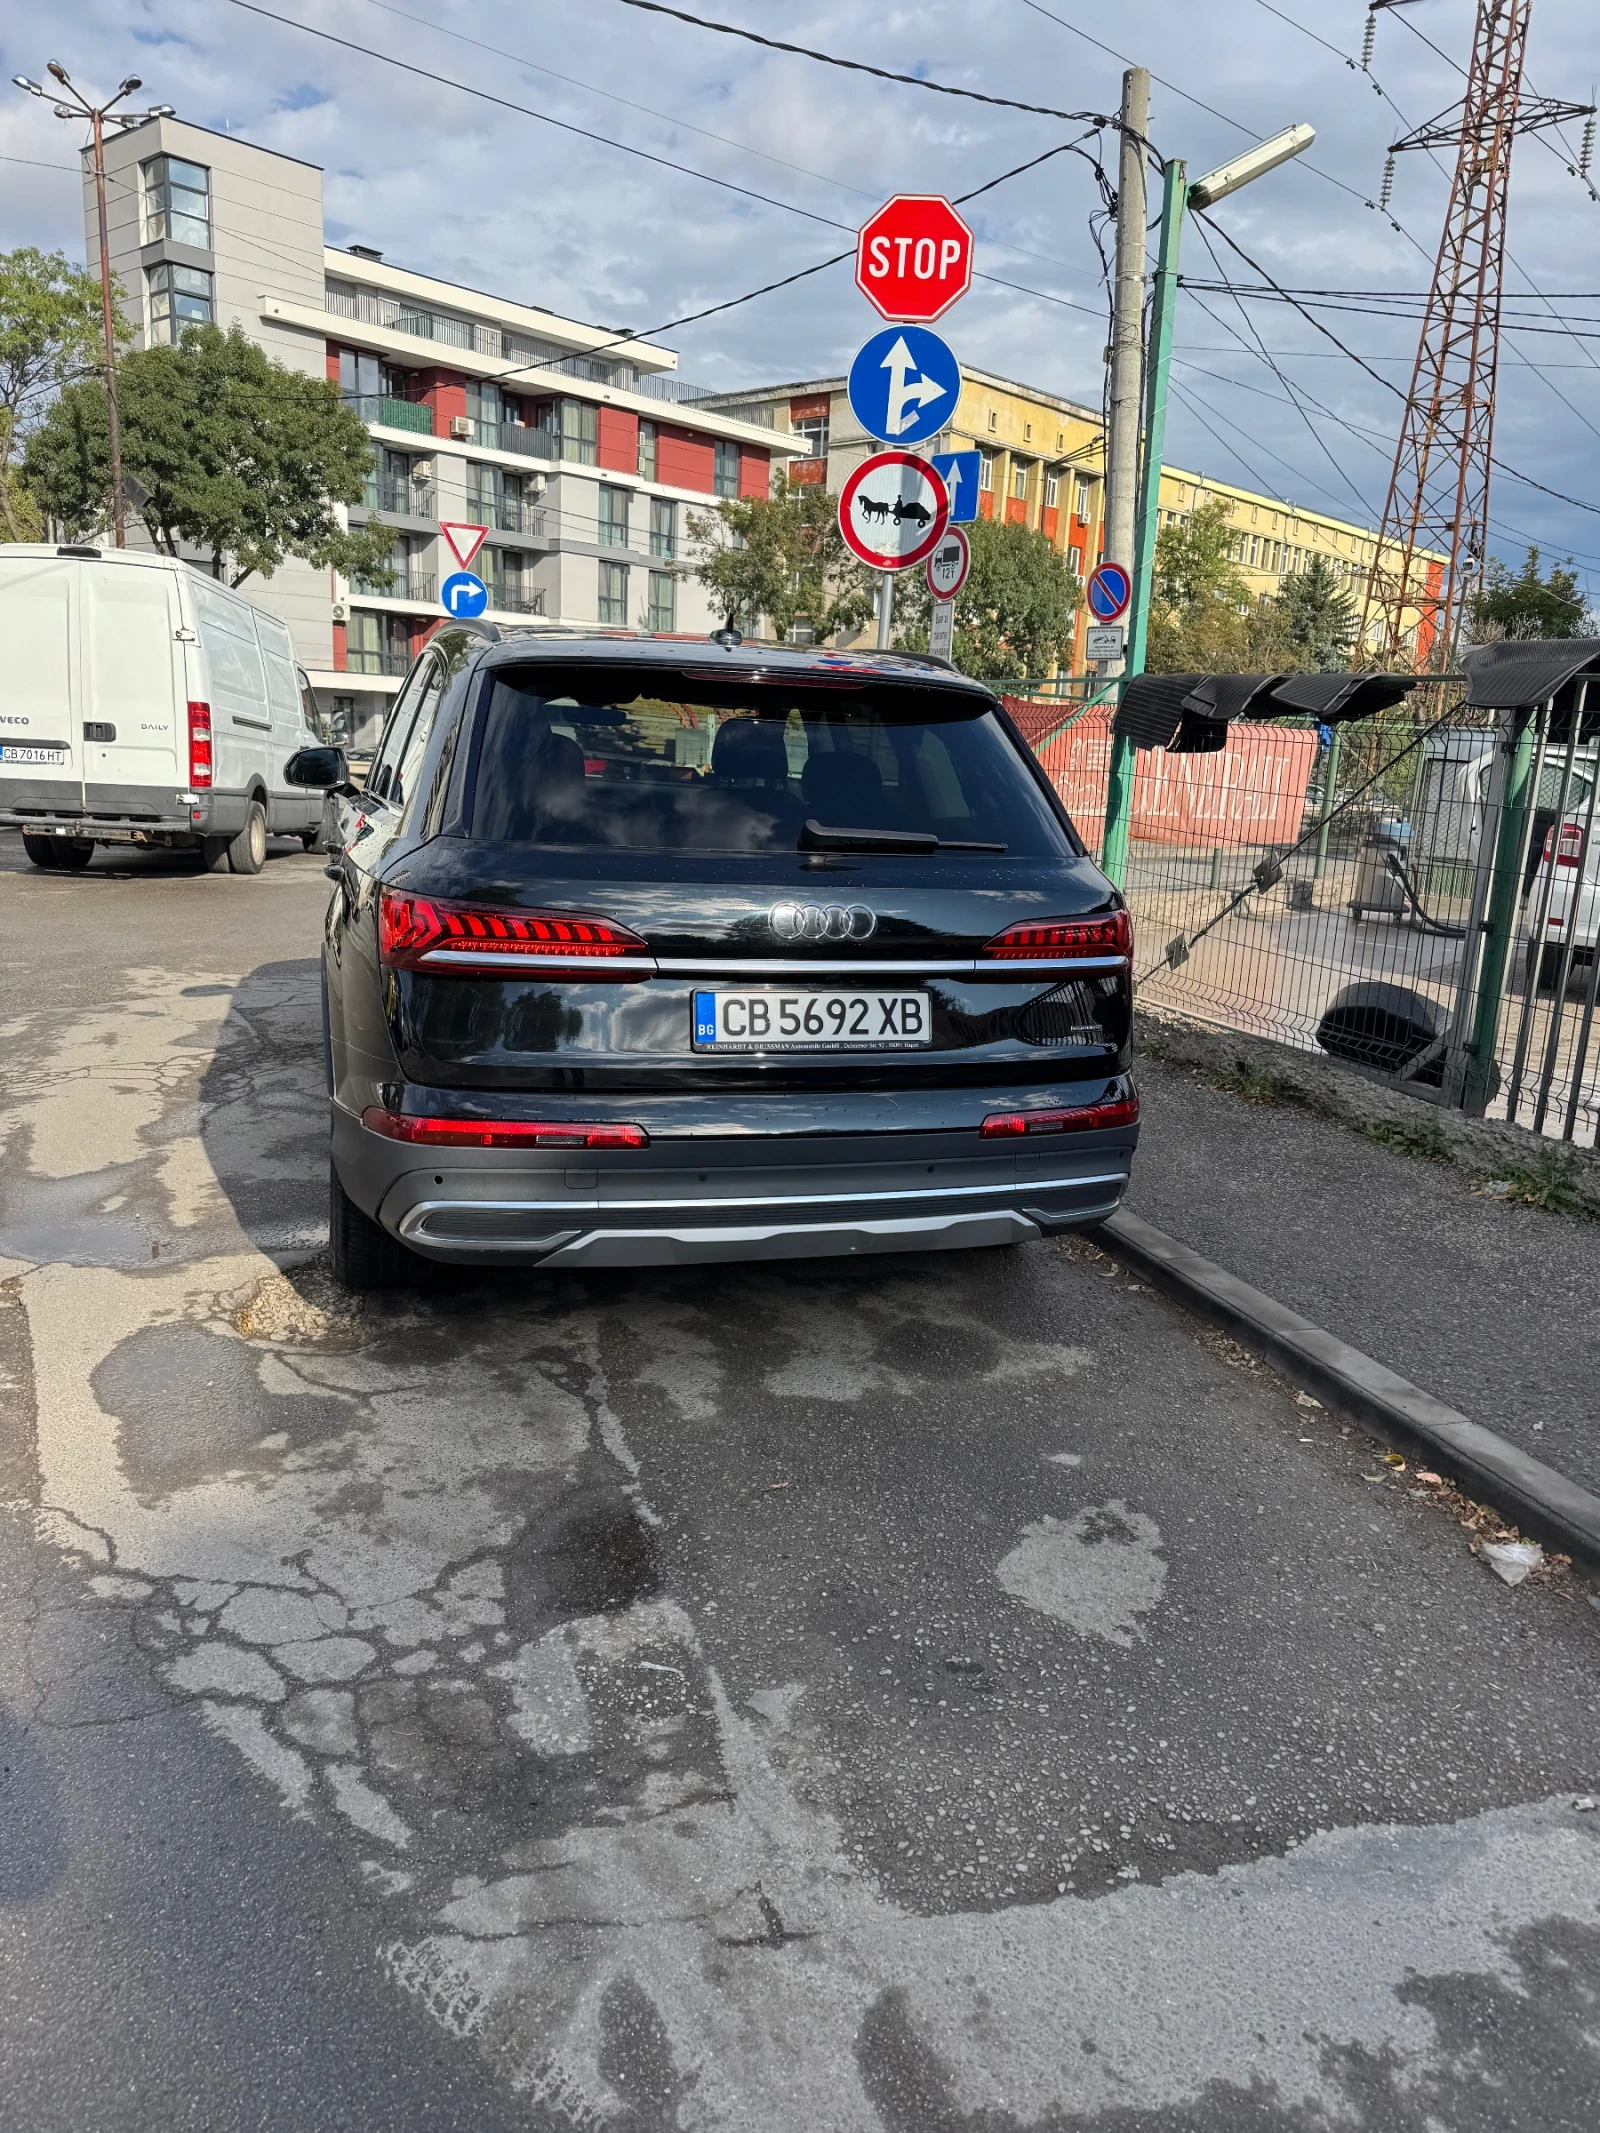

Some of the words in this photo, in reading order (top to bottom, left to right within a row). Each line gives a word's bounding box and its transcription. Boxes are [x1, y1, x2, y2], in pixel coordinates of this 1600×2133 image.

[868, 235, 961, 280] STOP
[4, 749, 18, 759] CB
[20, 750, 46, 760] 7016
[47, 751, 62, 761] HT
[723, 999, 770, 1036] CB
[780, 998, 869, 1035] 5692
[877, 998, 923, 1035] XB
[698, 1025, 714, 1035] BG
